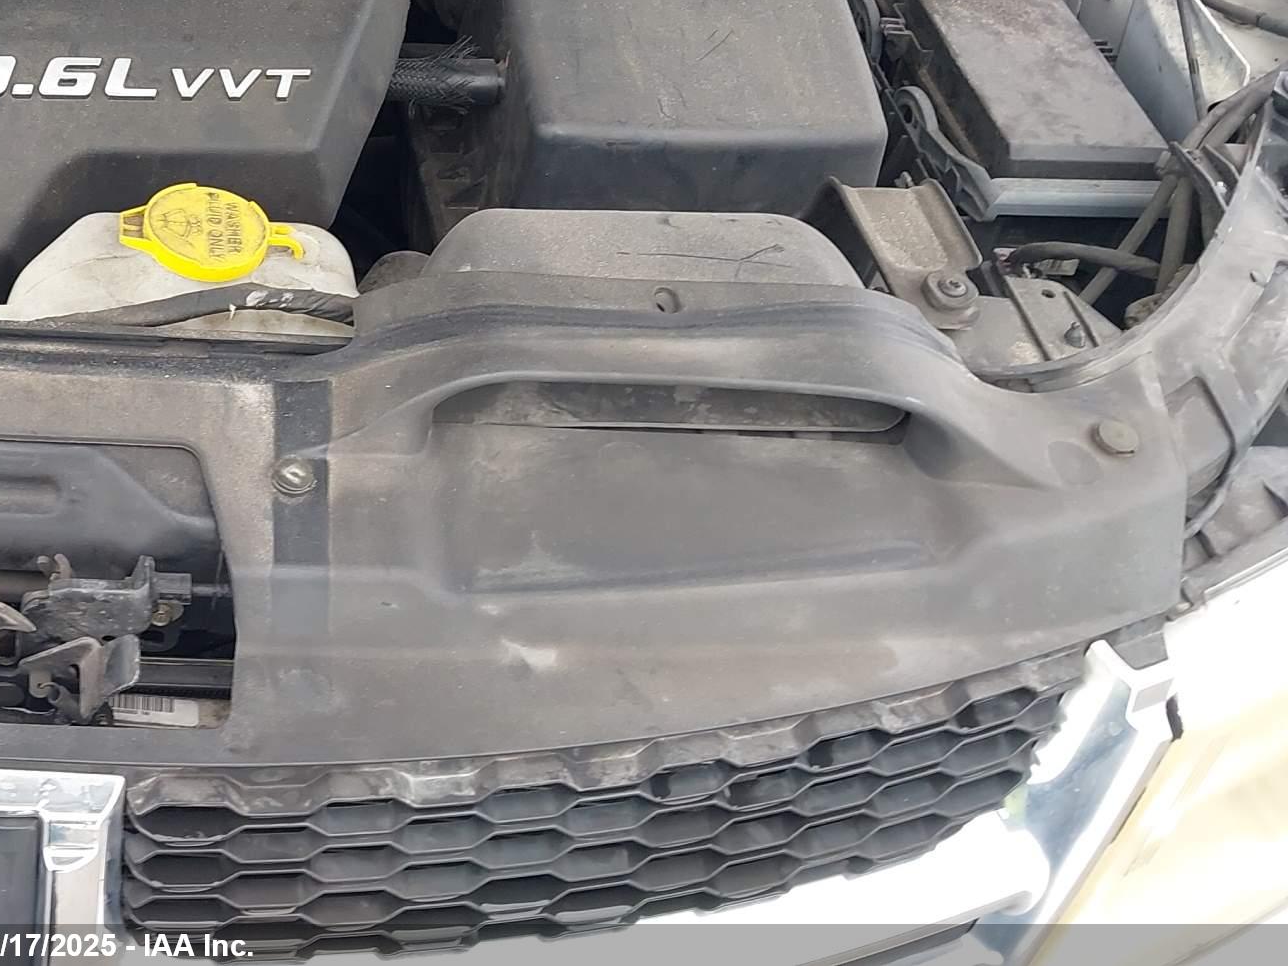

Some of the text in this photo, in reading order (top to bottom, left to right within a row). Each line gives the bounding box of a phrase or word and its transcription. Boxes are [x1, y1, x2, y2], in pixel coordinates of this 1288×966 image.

[171, 68, 312, 101] VVT
[207, 192, 225, 262] FLUID ONLY
[224, 202, 242, 253] WASHER
